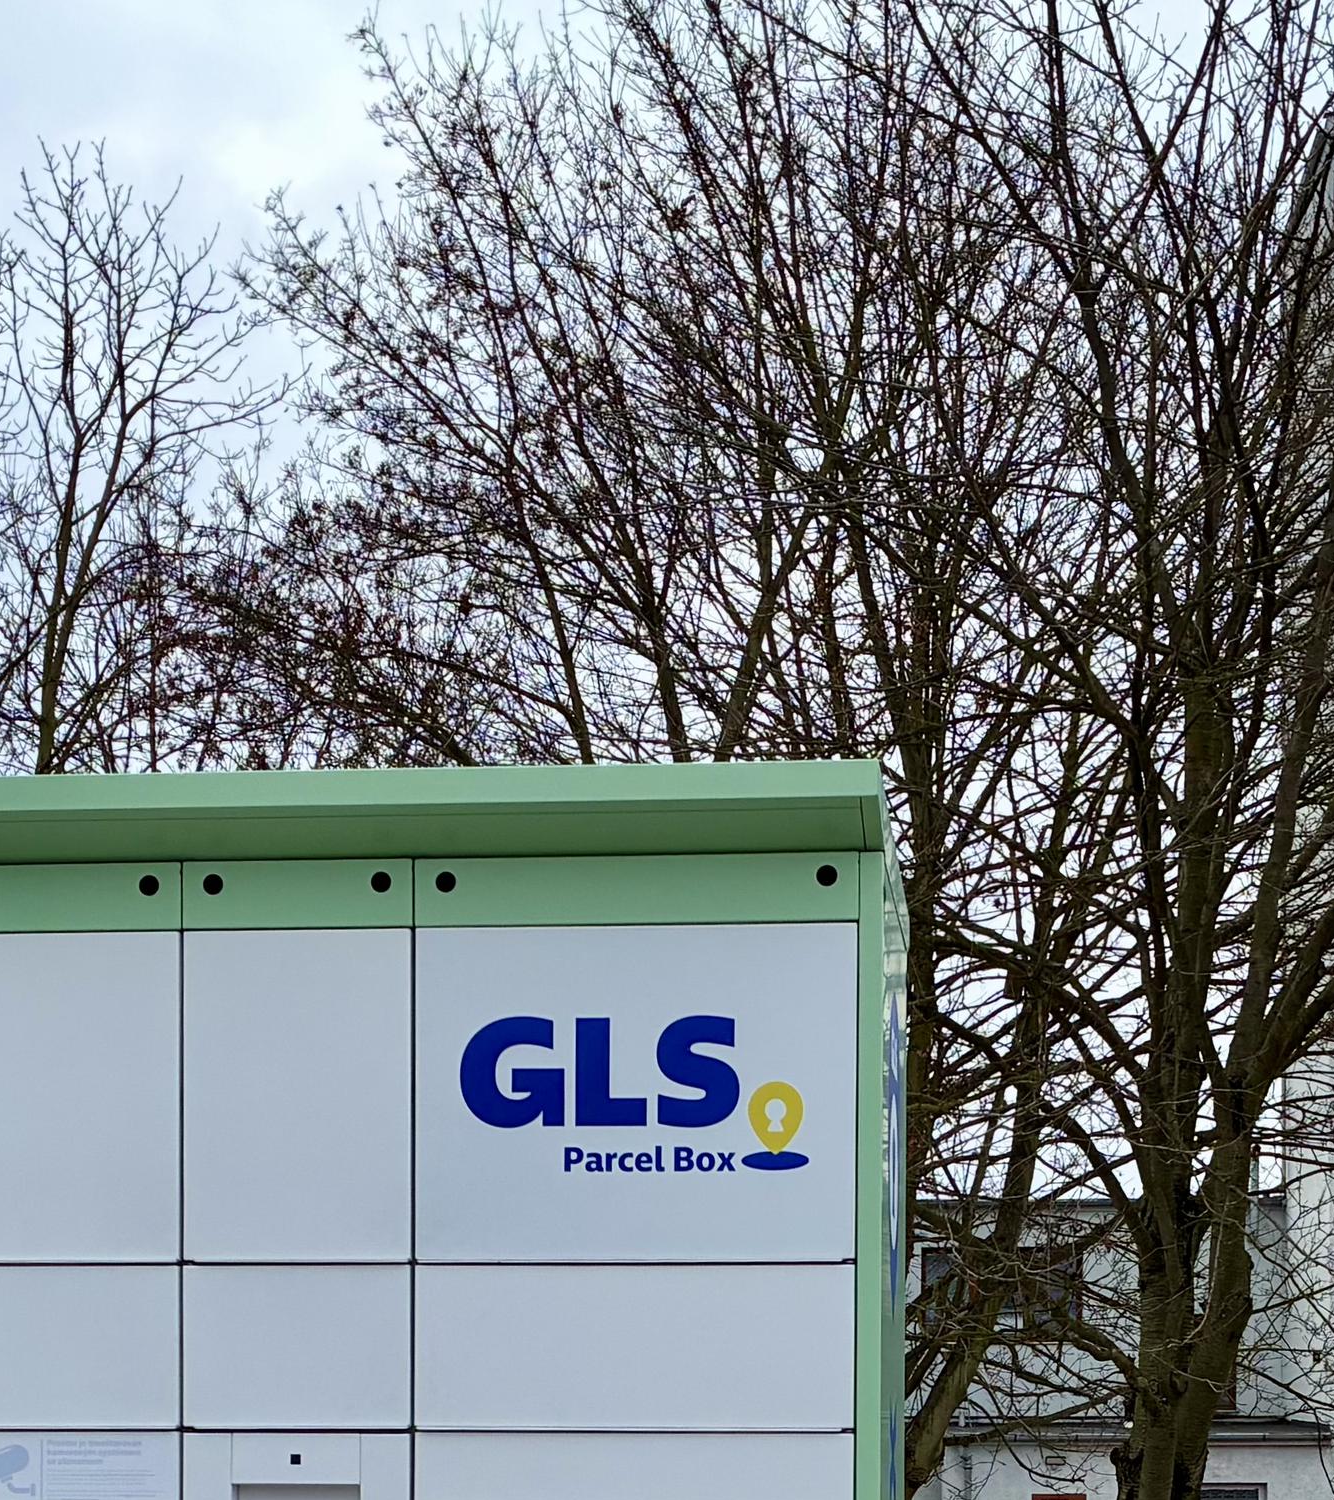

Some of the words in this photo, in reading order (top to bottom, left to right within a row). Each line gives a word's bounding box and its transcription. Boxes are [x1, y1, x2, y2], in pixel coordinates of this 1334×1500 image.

[460, 1015, 740, 1129] GLS
[563, 1145, 665, 1173] Parcel
[673, 1147, 736, 1173] Box
